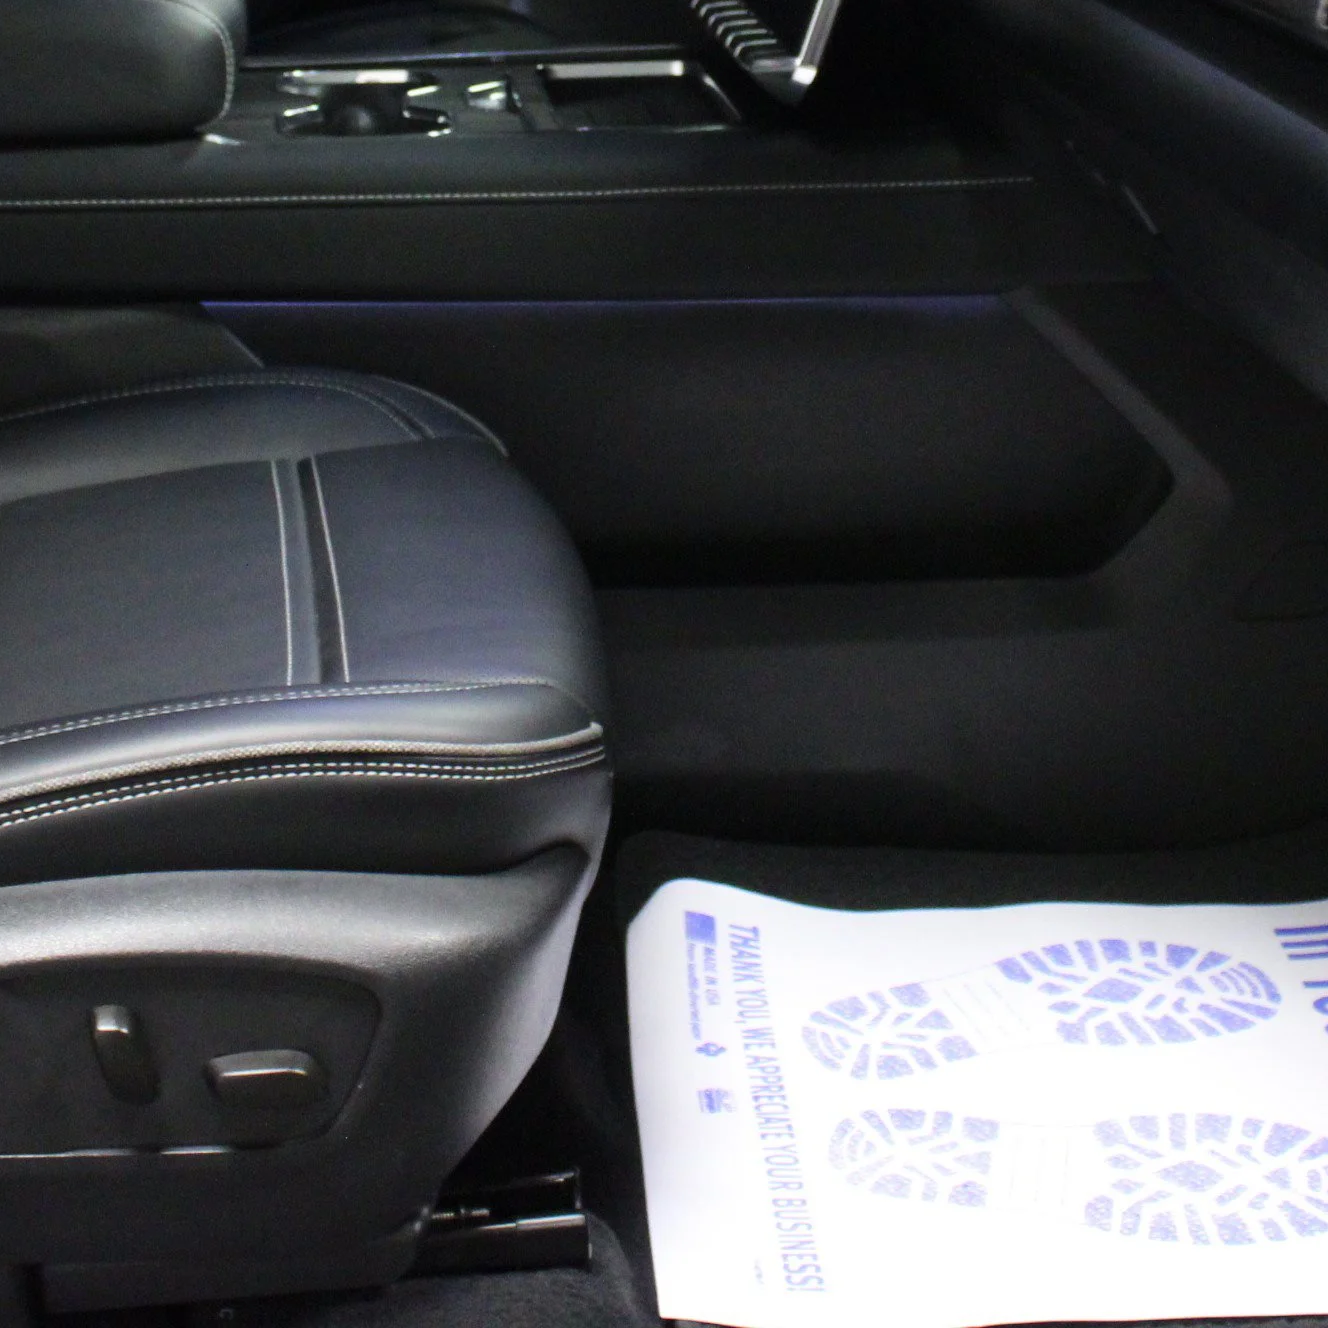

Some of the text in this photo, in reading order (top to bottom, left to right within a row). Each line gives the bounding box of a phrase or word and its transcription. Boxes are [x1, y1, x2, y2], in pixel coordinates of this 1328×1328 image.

[703, 945, 718, 973] MADE
[728, 923, 826, 1293] THANK YOU, WE APPRECIATE YOUR BUSINESS!
